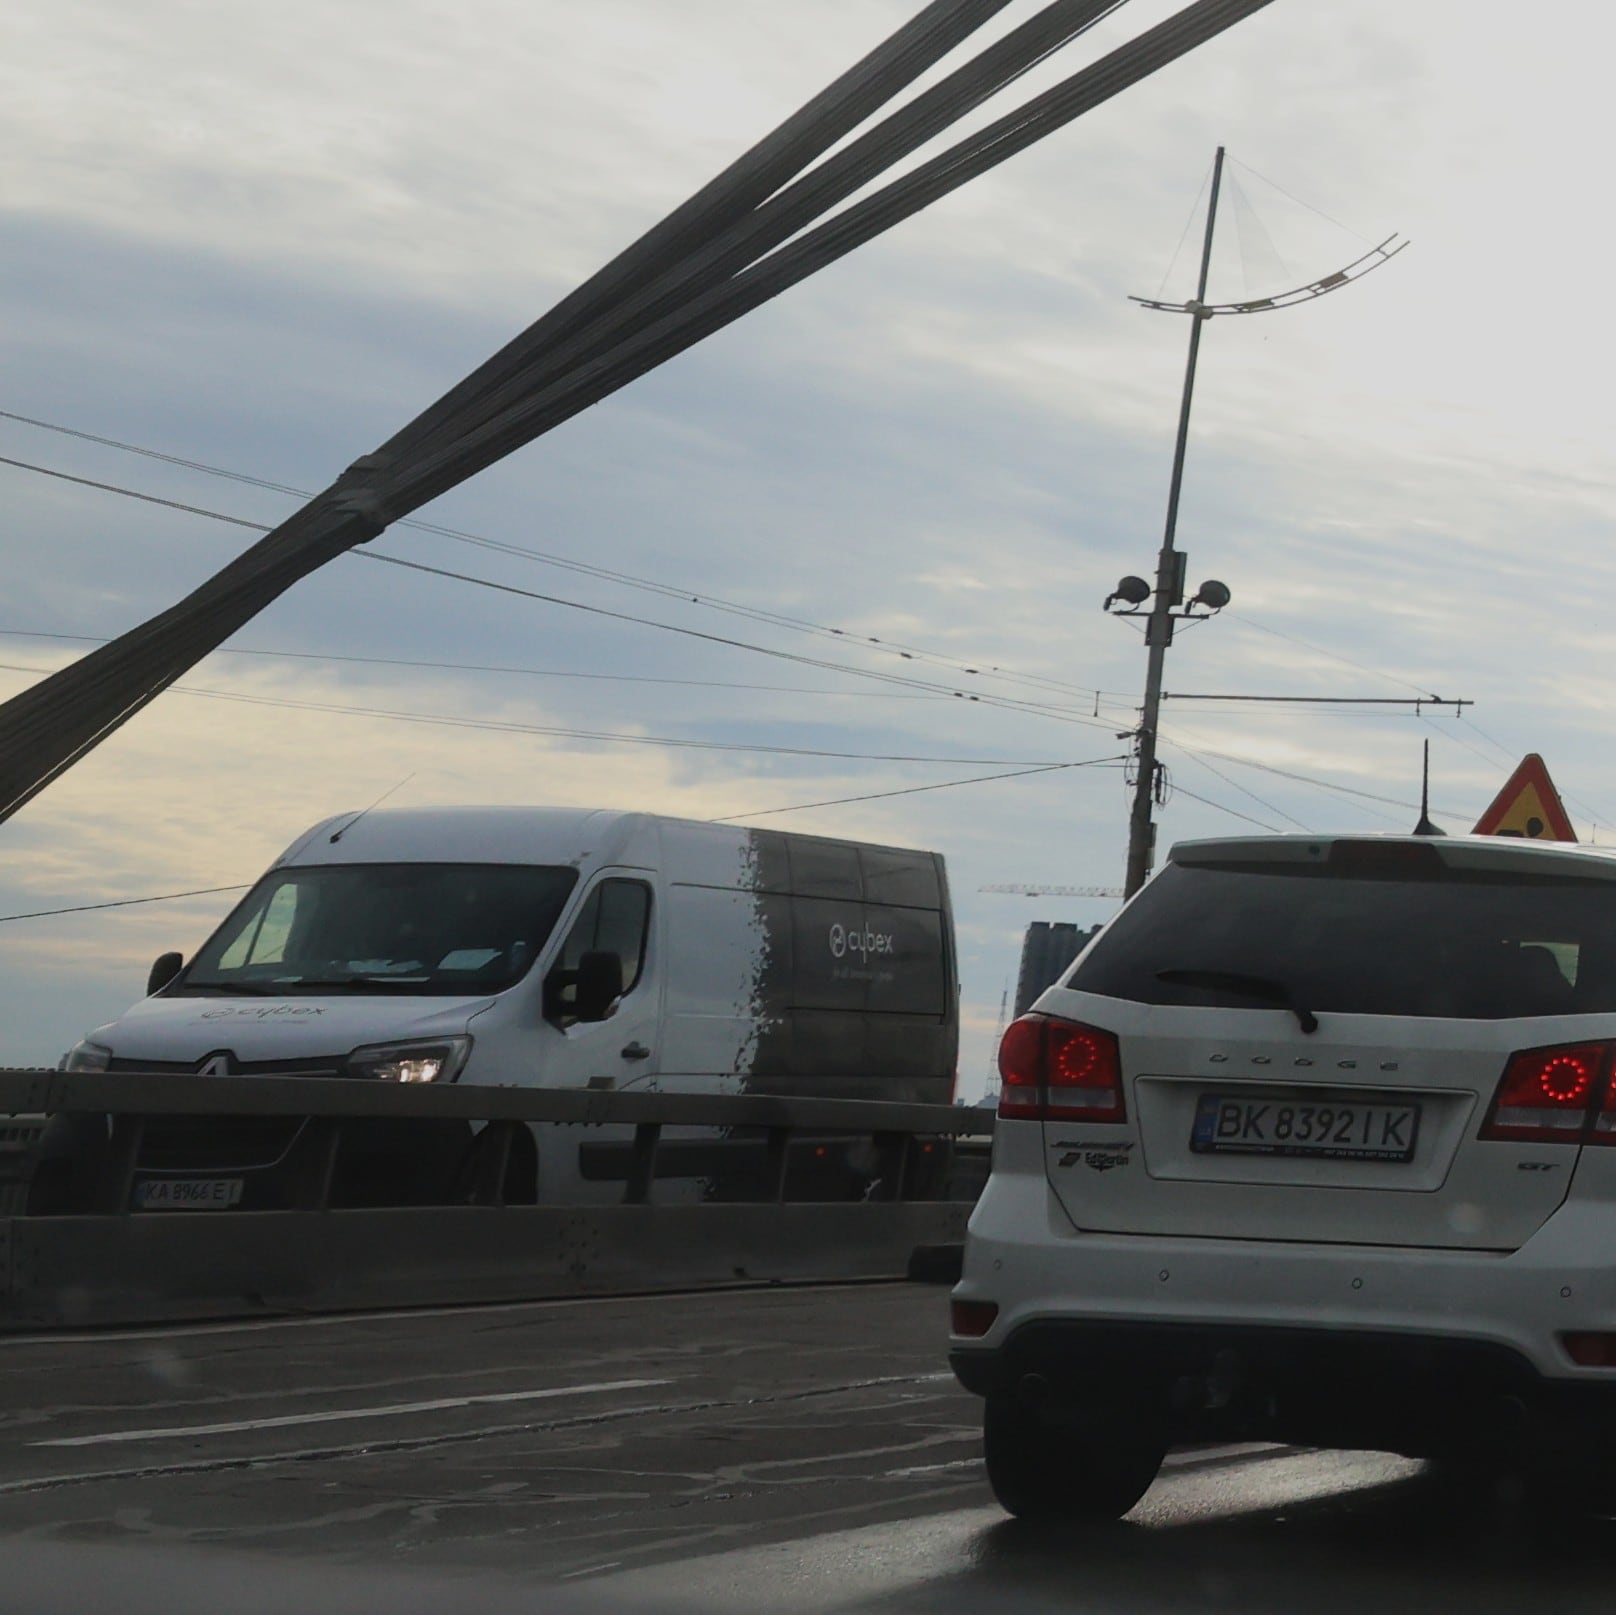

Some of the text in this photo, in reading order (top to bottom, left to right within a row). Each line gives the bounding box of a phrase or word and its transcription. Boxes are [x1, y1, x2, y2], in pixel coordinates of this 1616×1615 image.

[847, 921, 894, 964] cybex
[1217, 1103, 1270, 1140] BK
[1274, 1108, 1354, 1144] 8392
